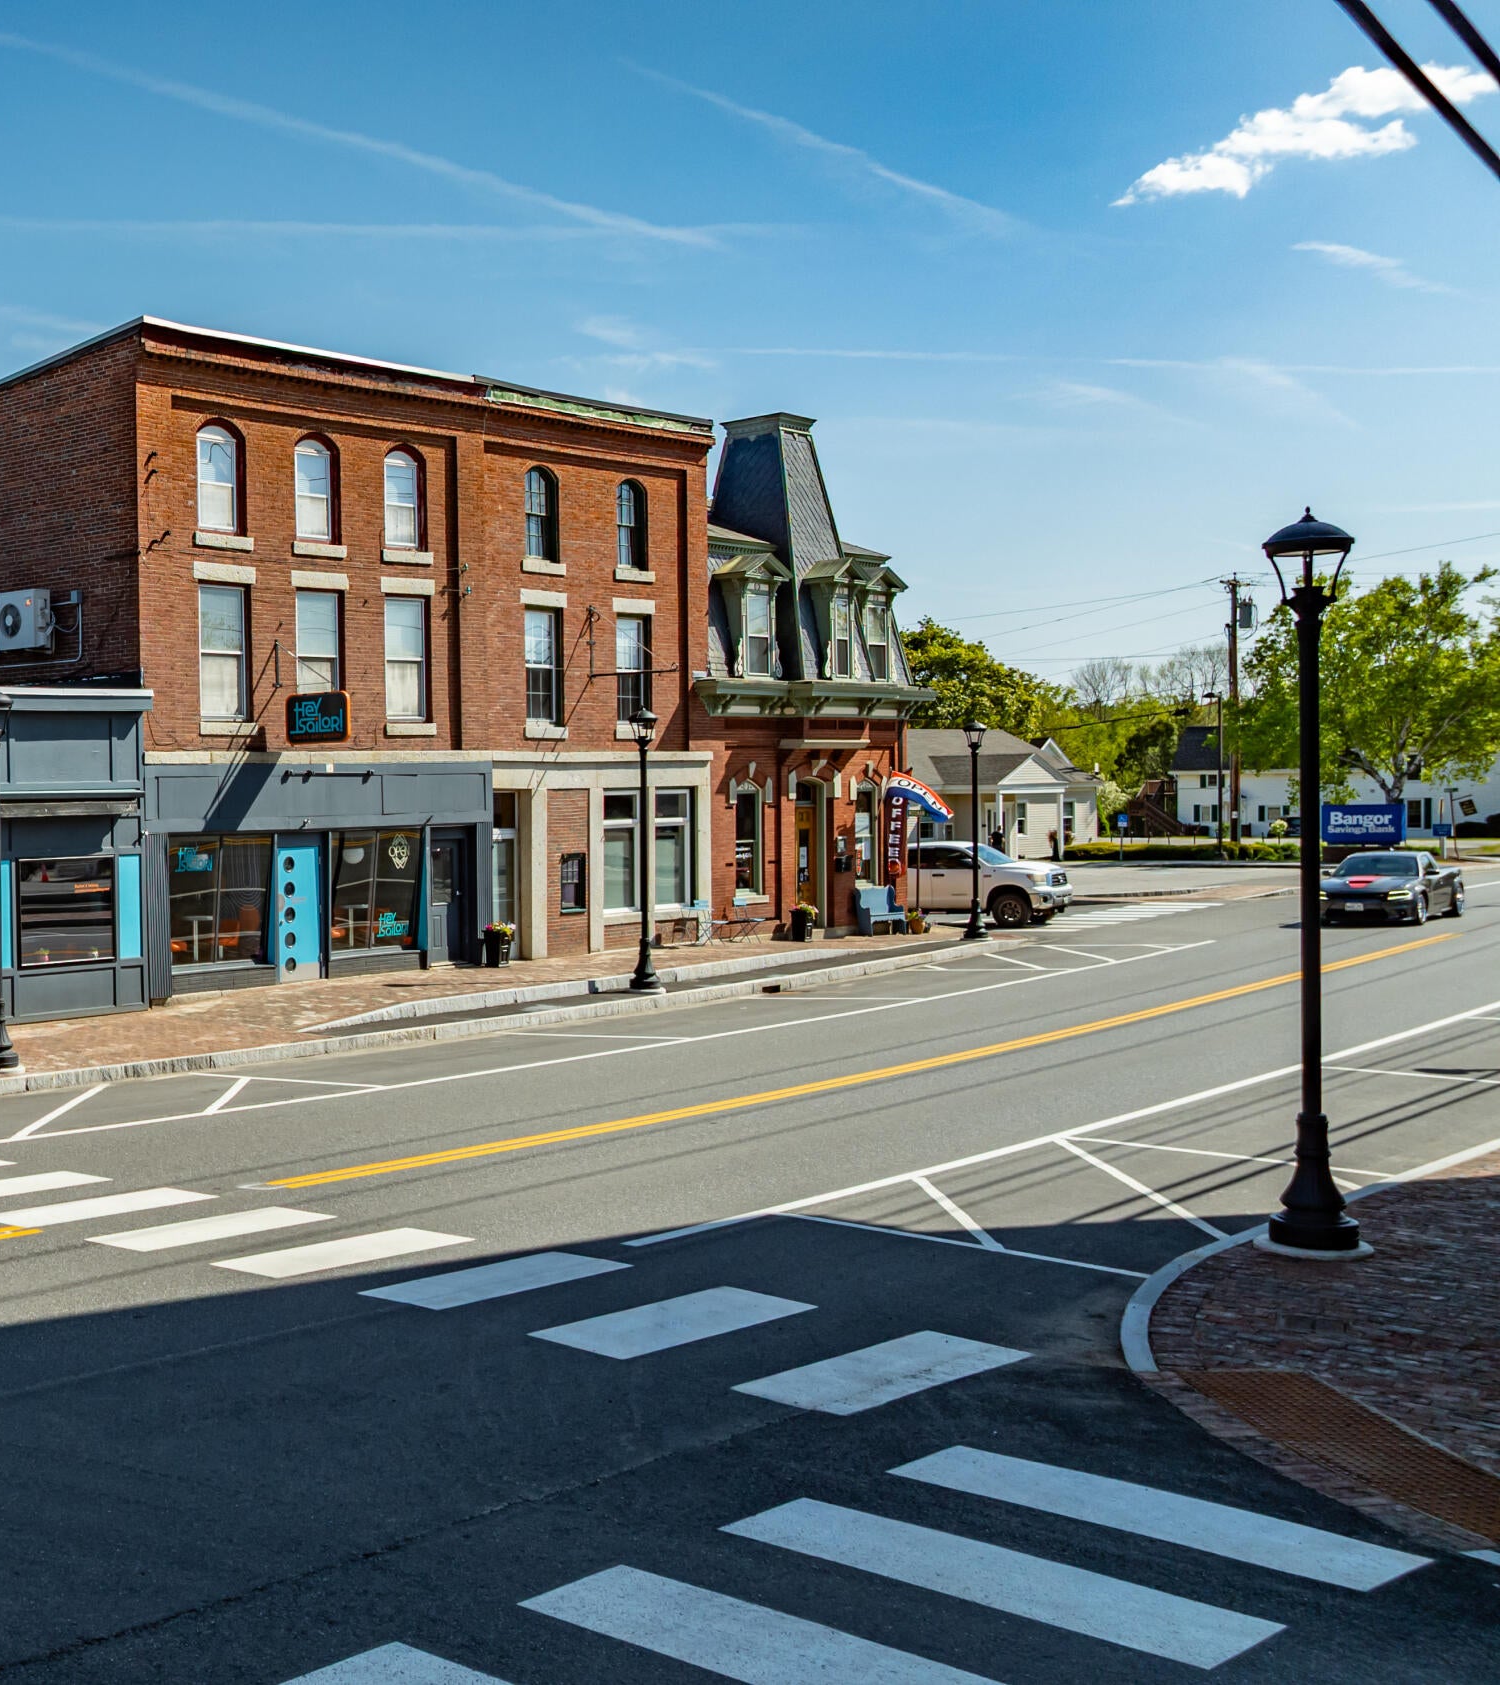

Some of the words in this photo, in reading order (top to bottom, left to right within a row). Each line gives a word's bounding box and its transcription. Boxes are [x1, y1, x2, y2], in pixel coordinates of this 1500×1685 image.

[897, 779, 943, 811] OPEN
[888, 796, 903, 857] OFFEE
[1327, 825, 1367, 834] Savings
[1368, 825, 1395, 833] Bank
[1330, 811, 1393, 827] Bangor
